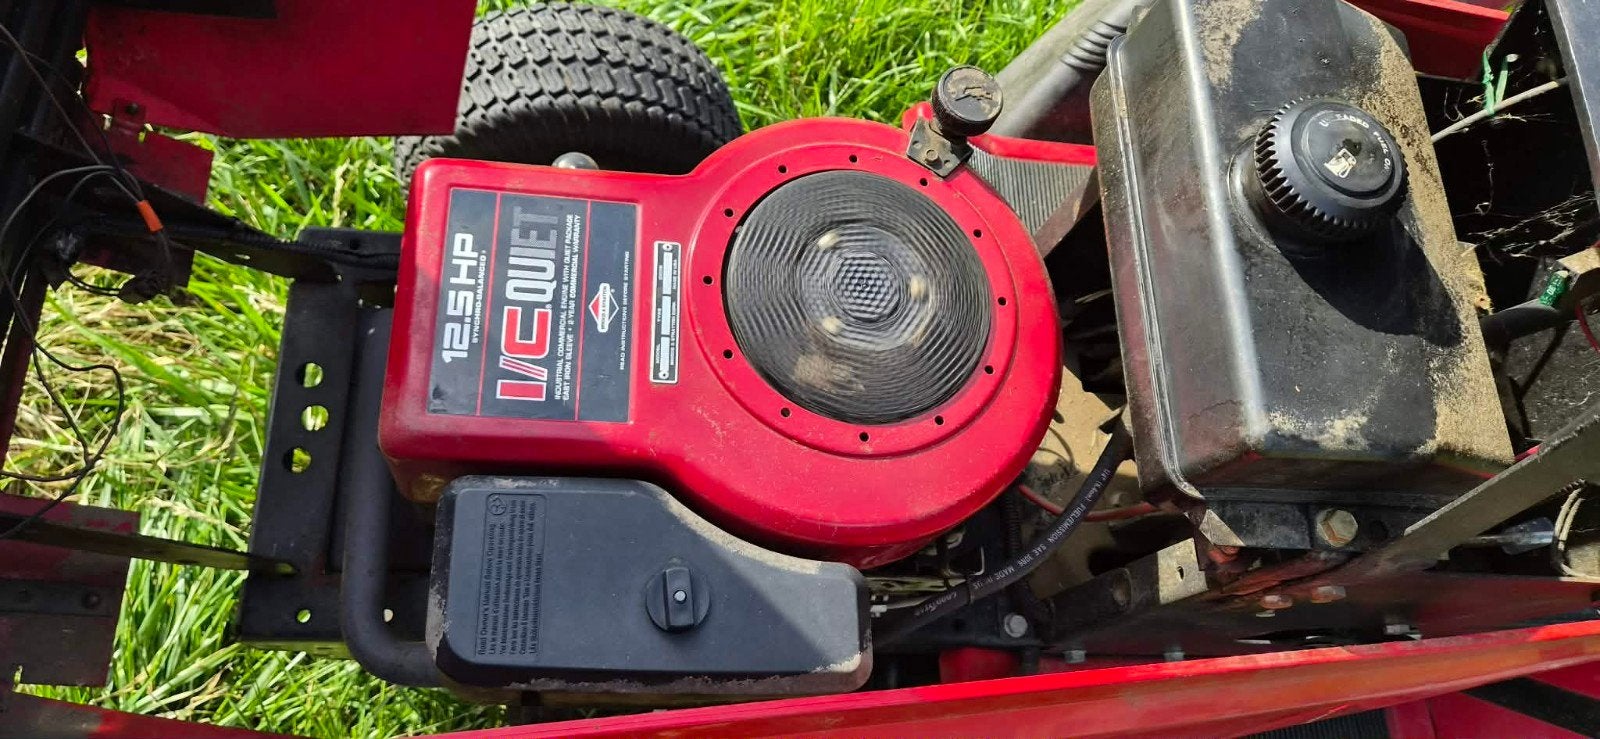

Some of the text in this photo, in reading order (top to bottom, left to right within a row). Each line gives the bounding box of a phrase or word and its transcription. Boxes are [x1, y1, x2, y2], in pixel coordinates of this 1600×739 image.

[1319, 113, 1370, 129] UEADED
[1373, 131, 1389, 155] FUEL
[565, 214, 574, 244] PACKAGE
[572, 214, 580, 253] WARRANTY
[505, 206, 558, 302] QUIET
[564, 245, 572, 264] QUIET
[561, 284, 569, 309] ENGINE
[569, 254, 579, 298] COMMERCIAL
[442, 233, 479, 363] 12.5 HP
[472, 254, 487, 343] SYNCHRO-BALANCED
[557, 311, 567, 357] COMMERCIAL
[565, 334, 574, 360] SLEEVE
[554, 359, 564, 400] INDUSTRIAL
[564, 362, 572, 379] IRON
[1047, 503, 1087, 544] FUEL/EMISSION
[1032, 543, 1047, 556] SAE
[478, 524, 496, 655] Read Owner's Manual Before Operating
[994, 565, 1015, 580] MADE
